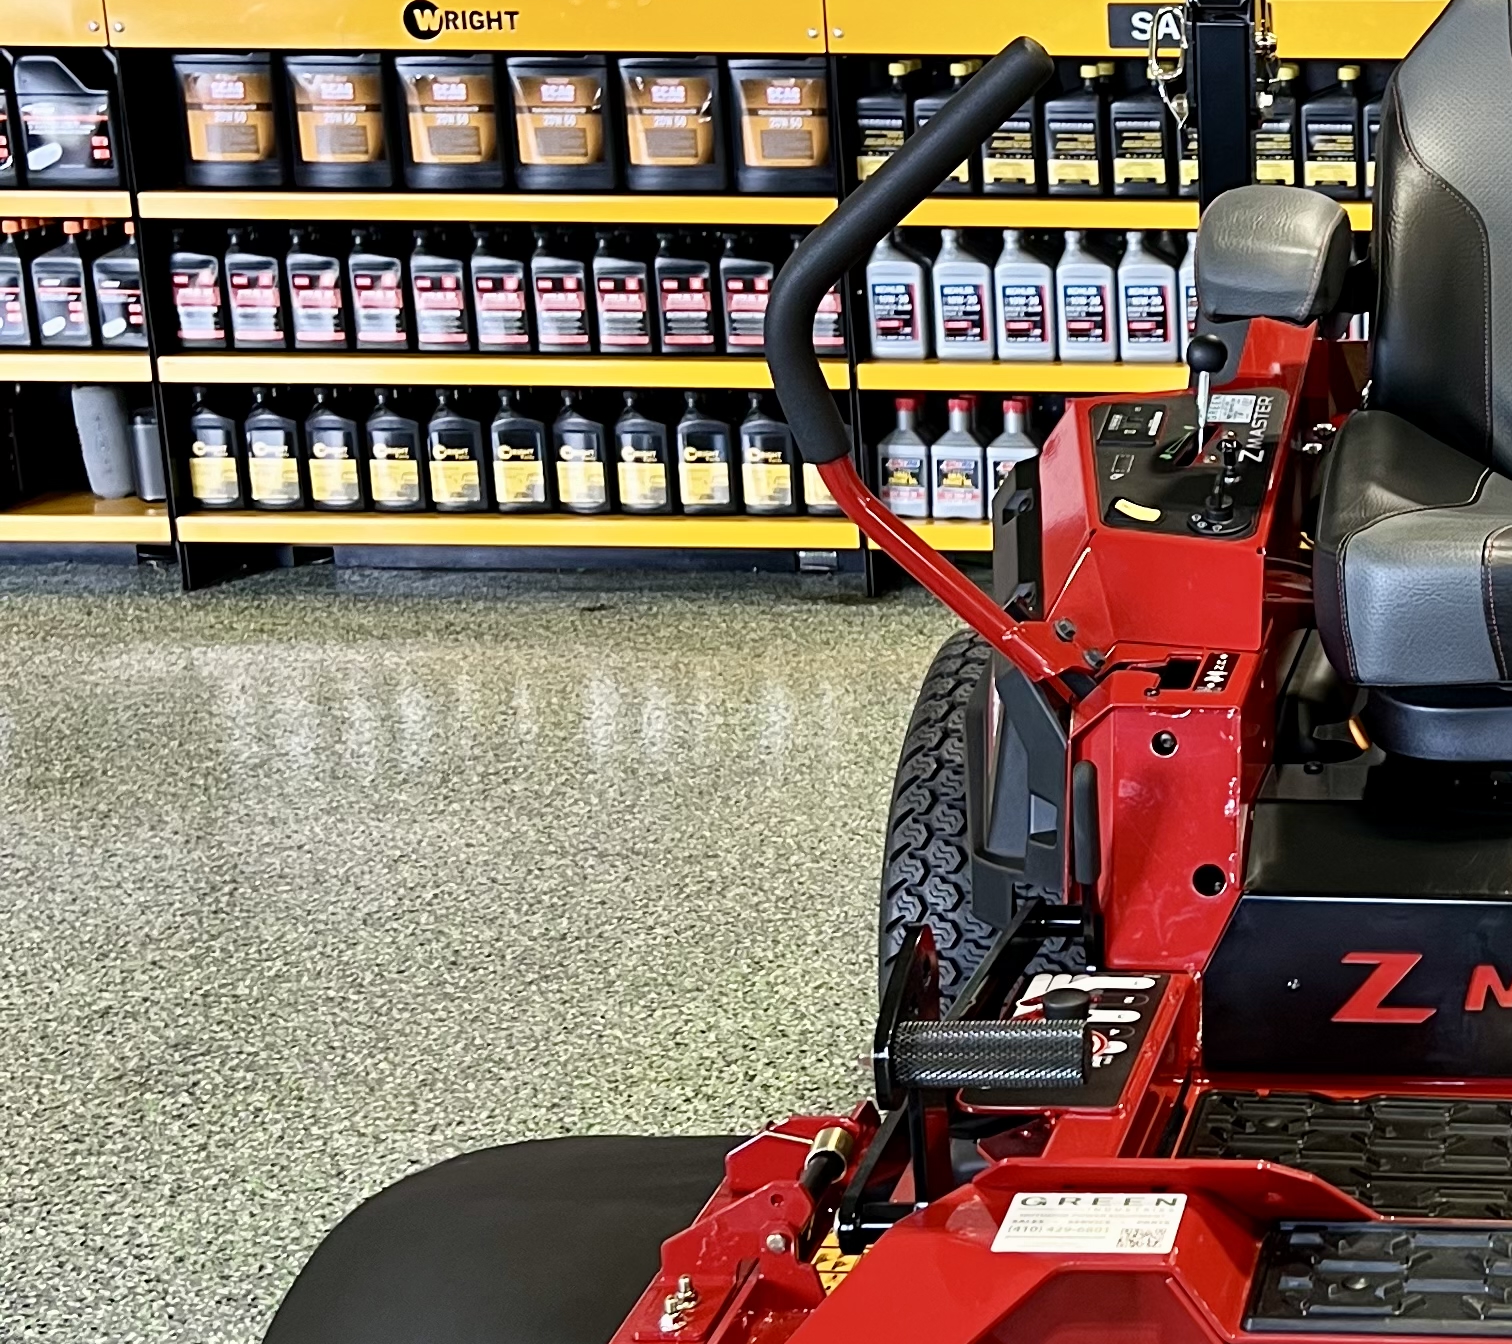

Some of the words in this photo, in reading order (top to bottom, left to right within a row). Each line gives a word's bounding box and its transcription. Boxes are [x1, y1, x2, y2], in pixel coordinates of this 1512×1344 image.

[404, 2, 519, 36] WRIGHT
[1246, 396, 1275, 449] MASTER
[1238, 449, 1265, 463] Z
[1331, 951, 1437, 1023] Z
[1020, 1196, 1178, 1207] GREEN
